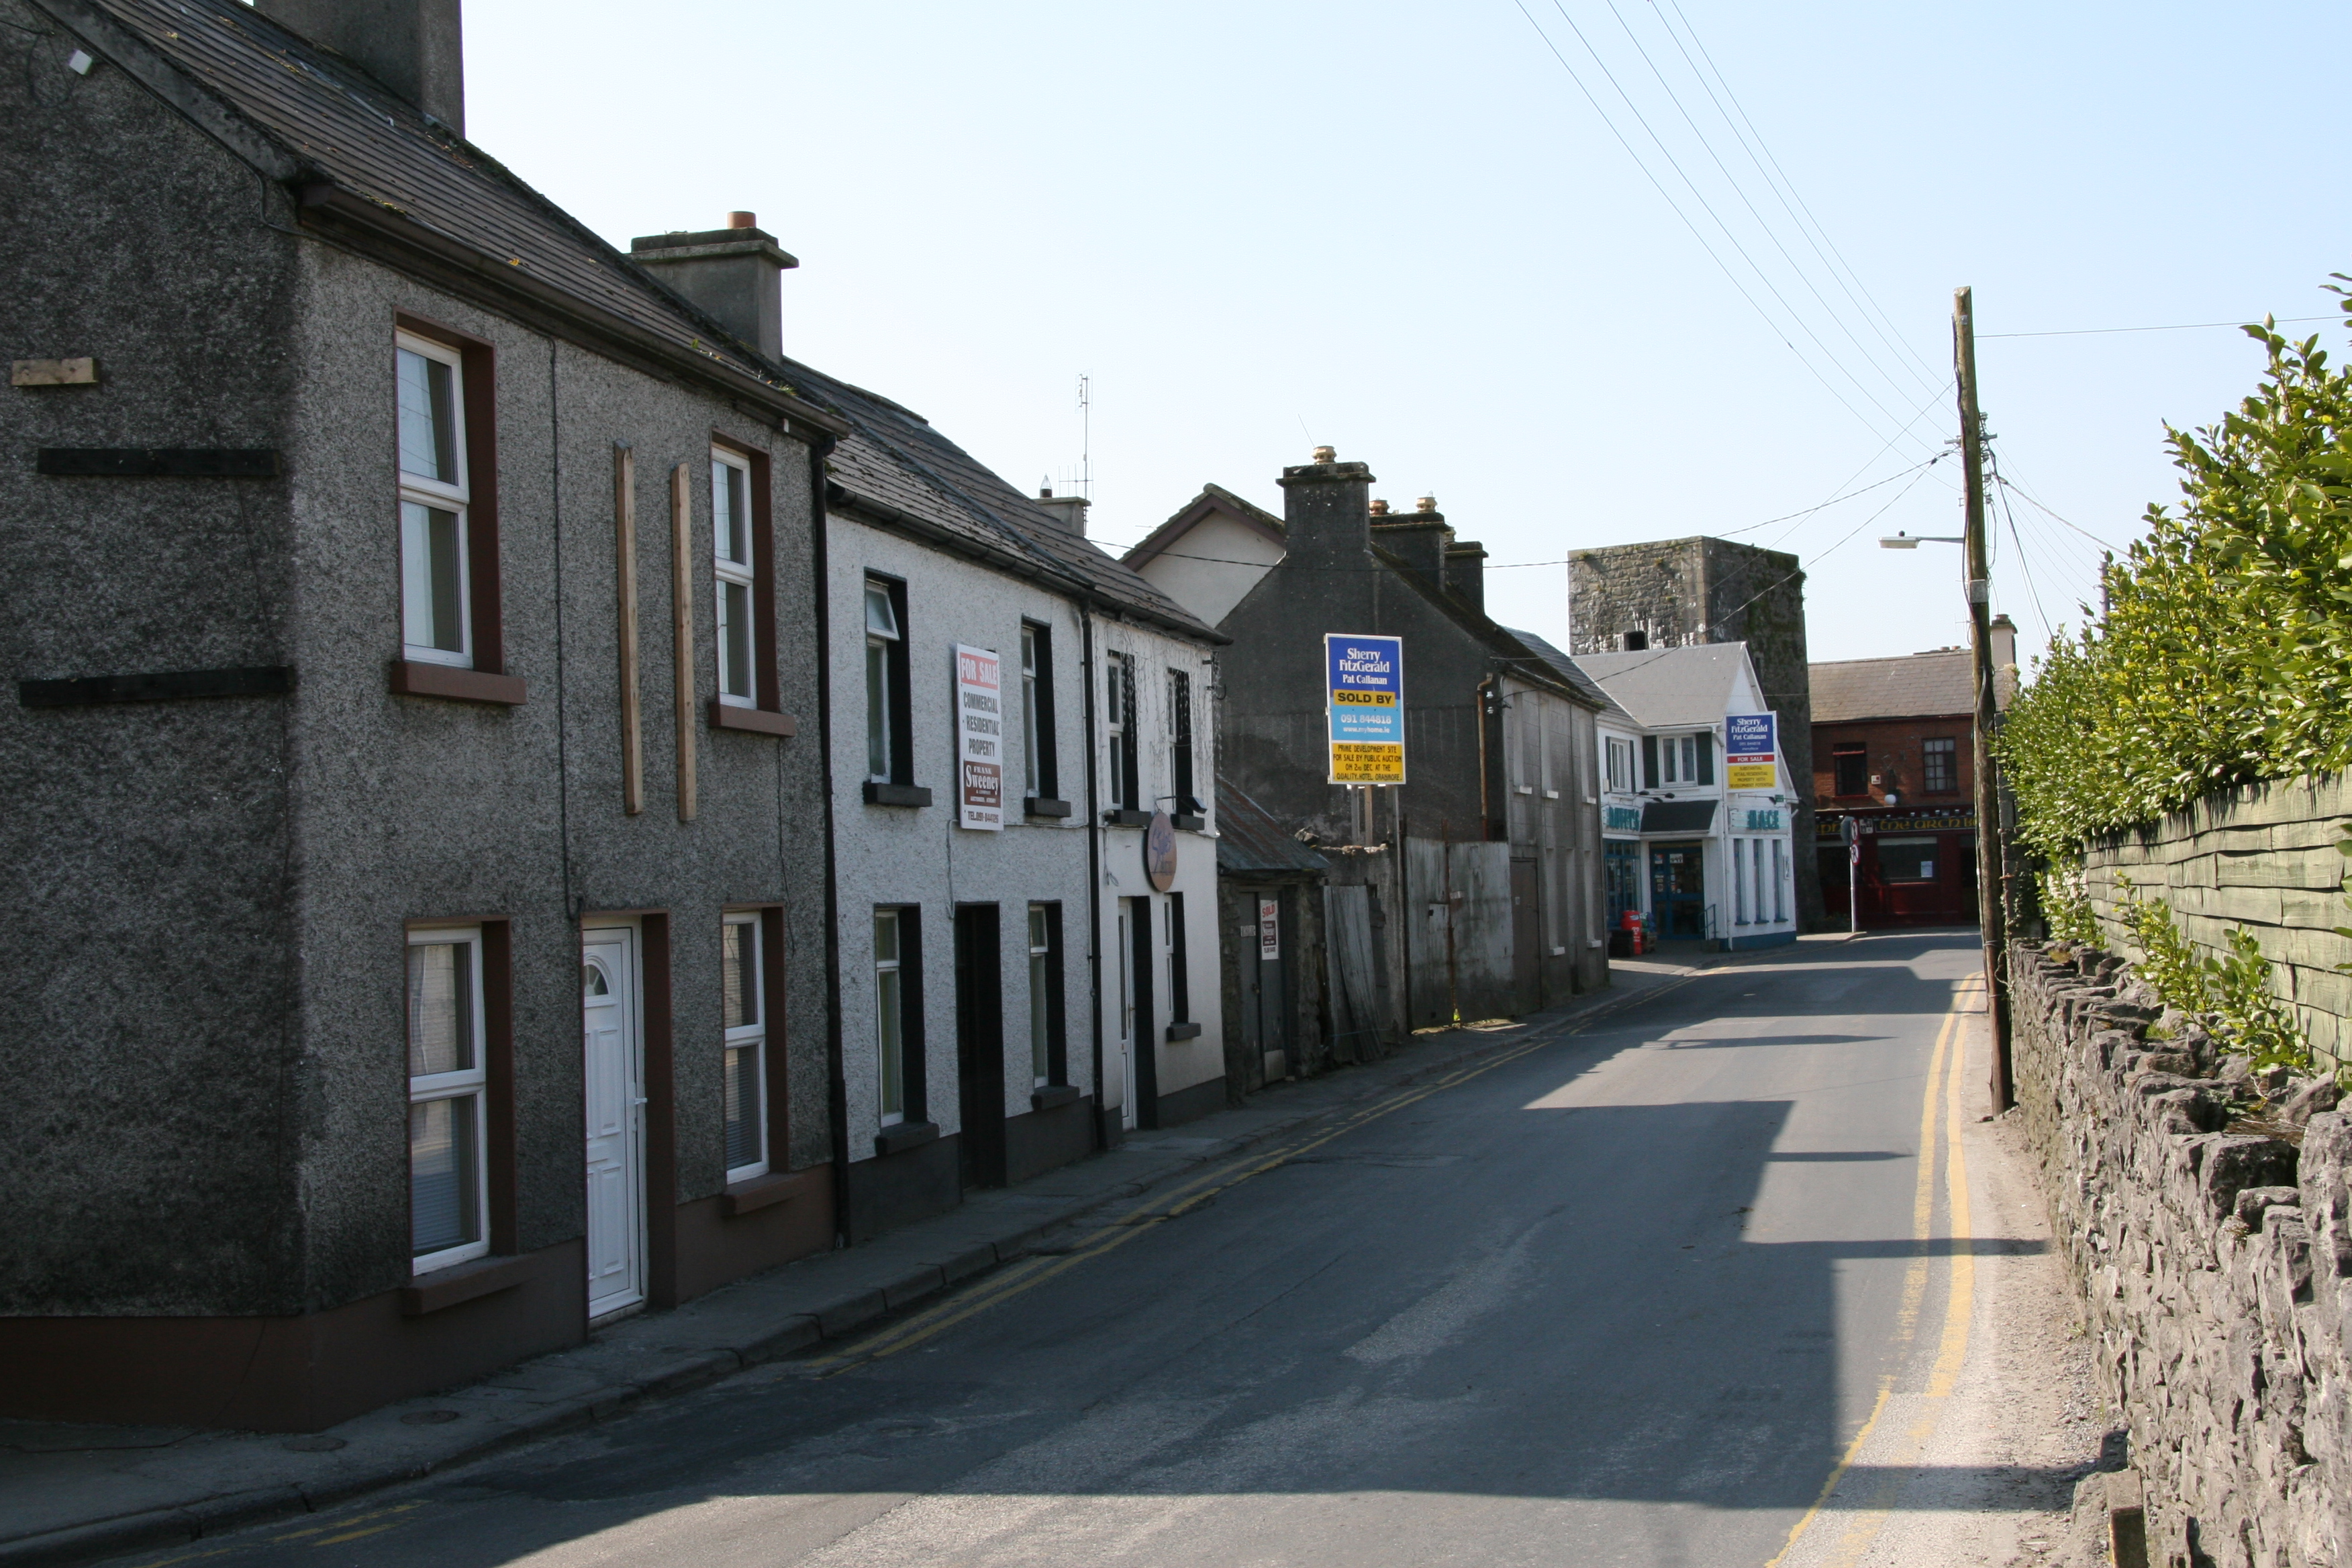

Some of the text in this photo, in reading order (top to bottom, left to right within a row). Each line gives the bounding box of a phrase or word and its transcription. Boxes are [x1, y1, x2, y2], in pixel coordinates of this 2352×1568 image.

[1347, 648, 1381, 663] Sherry
[961, 657, 997, 685] FOR SALE
[1339, 660, 1390, 673] FitzGerald
[1342, 675, 1387, 685] Pat Callanan
[963, 691, 998, 714] COMMERCIAL
[1338, 693, 1392, 704] SOLD BY
[1341, 714, 1357, 724] 091
[1737, 718, 1761, 726] Sherry
[1731, 725, 1768, 733] FitzGerald
[969, 738, 995, 756] PROPERTY
[973, 766, 992, 775] FRANK
[966, 765, 999, 795] Sweeney
[1263, 904, 1275, 918] SOLD
